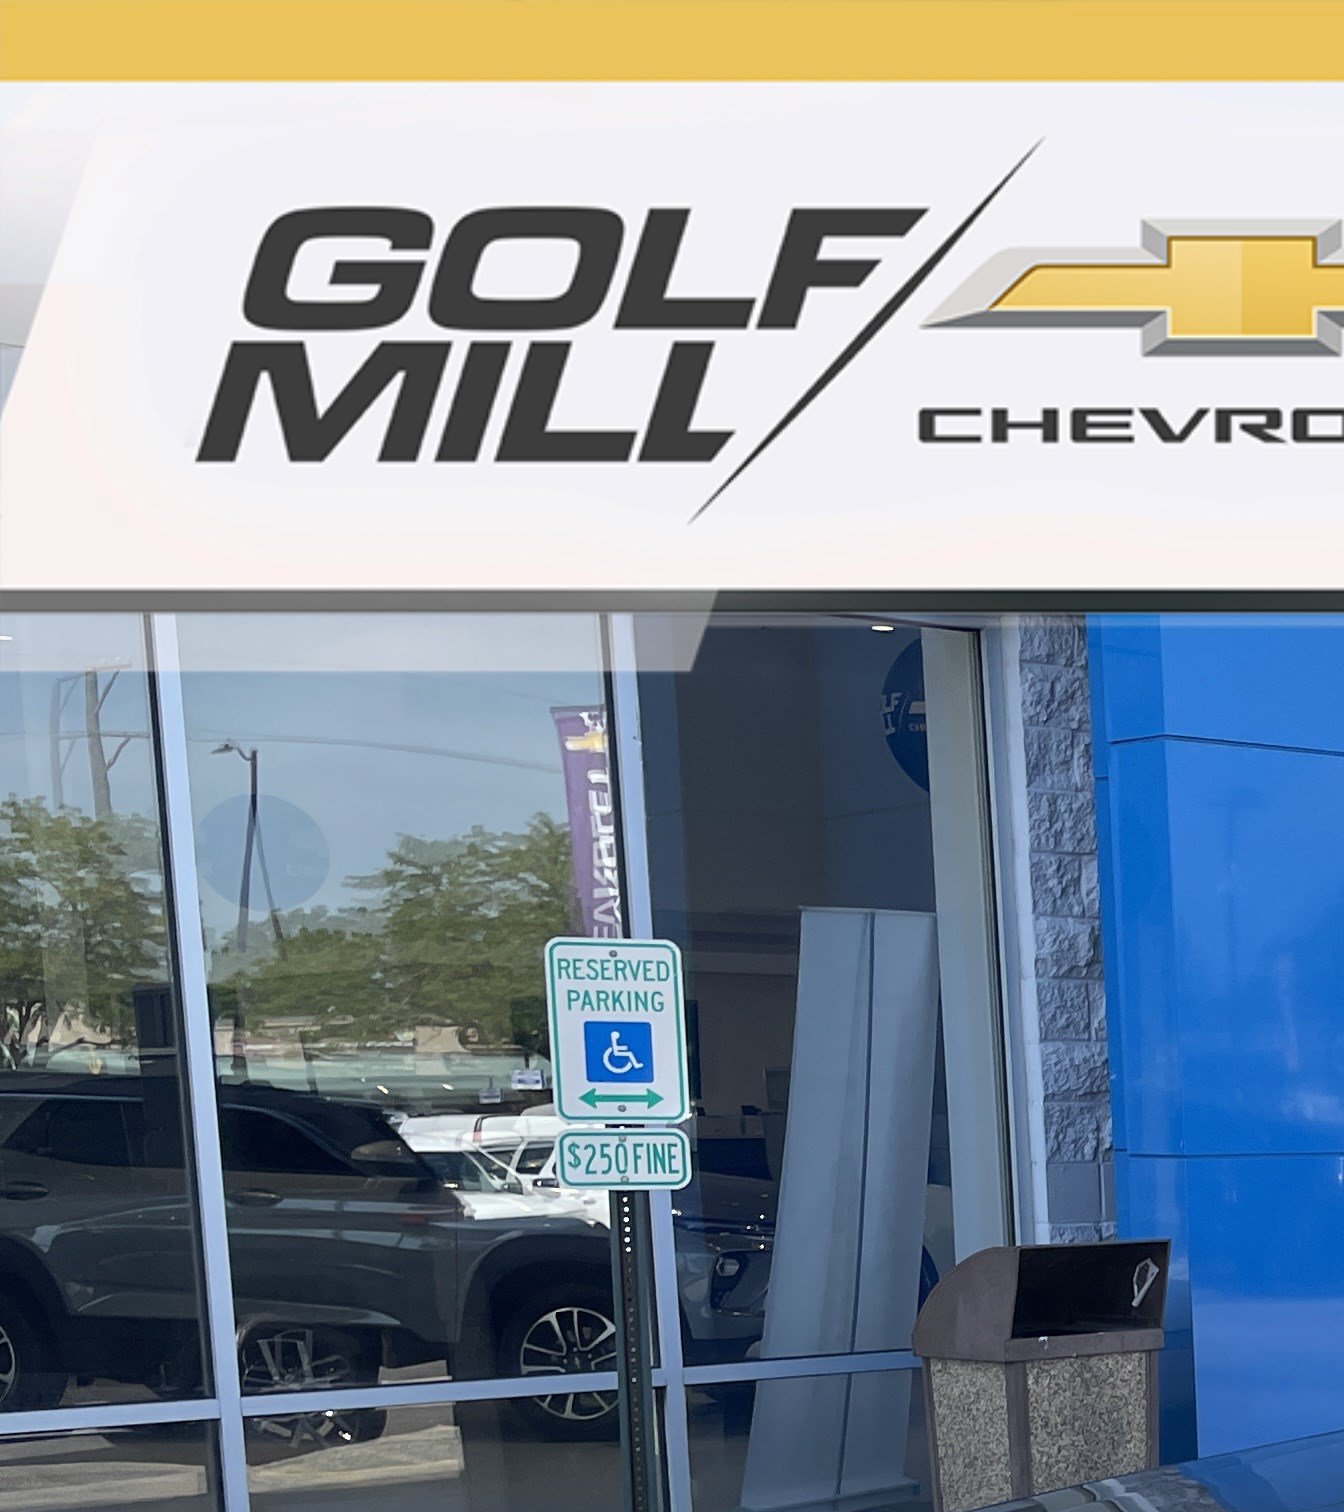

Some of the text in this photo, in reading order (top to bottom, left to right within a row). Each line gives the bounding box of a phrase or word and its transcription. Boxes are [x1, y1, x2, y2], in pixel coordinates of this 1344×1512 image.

[557, 958, 670, 982] RESERVED
[567, 990, 665, 1013] PARKING
[567, 1142, 680, 1175] $250 FINE
